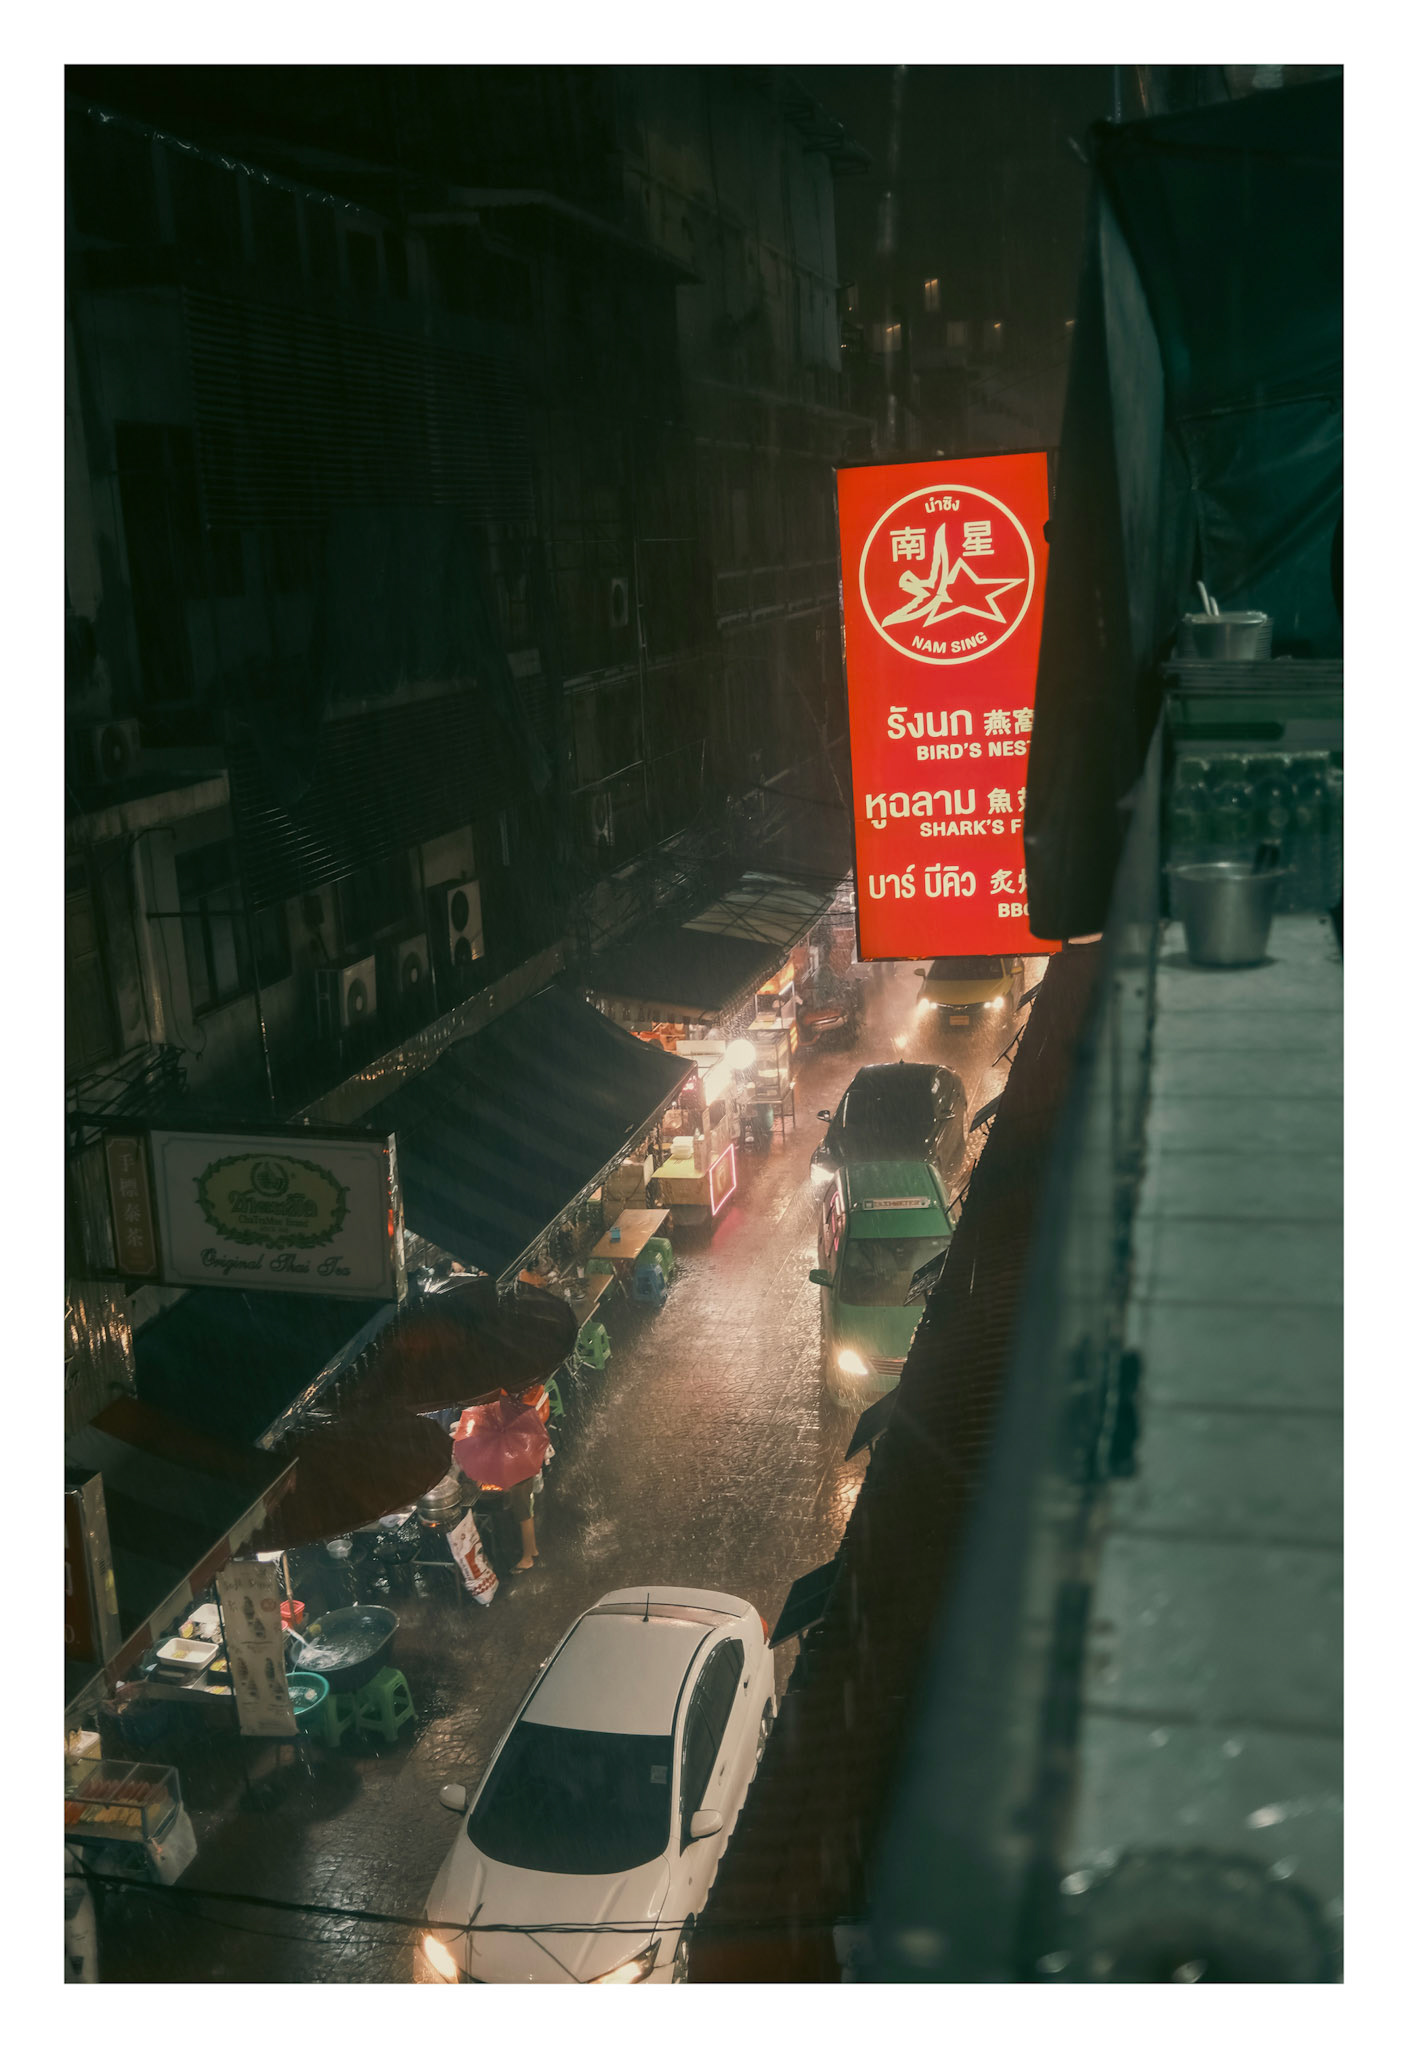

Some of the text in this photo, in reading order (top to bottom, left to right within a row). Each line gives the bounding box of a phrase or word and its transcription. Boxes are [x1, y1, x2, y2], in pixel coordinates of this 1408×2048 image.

[889, 520, 995, 563] 南 星
[911, 631, 988, 654] NAM SING
[887, 705, 973, 740] รังนก
[916, 739, 1032, 761] BIRD'S NES
[865, 788, 977, 831] หูฉลาม
[919, 818, 1005, 838] SHARK'S
[868, 862, 977, 900] บาร์ บีคิว
[199, 1247, 351, 1277] Original Thai Tea
